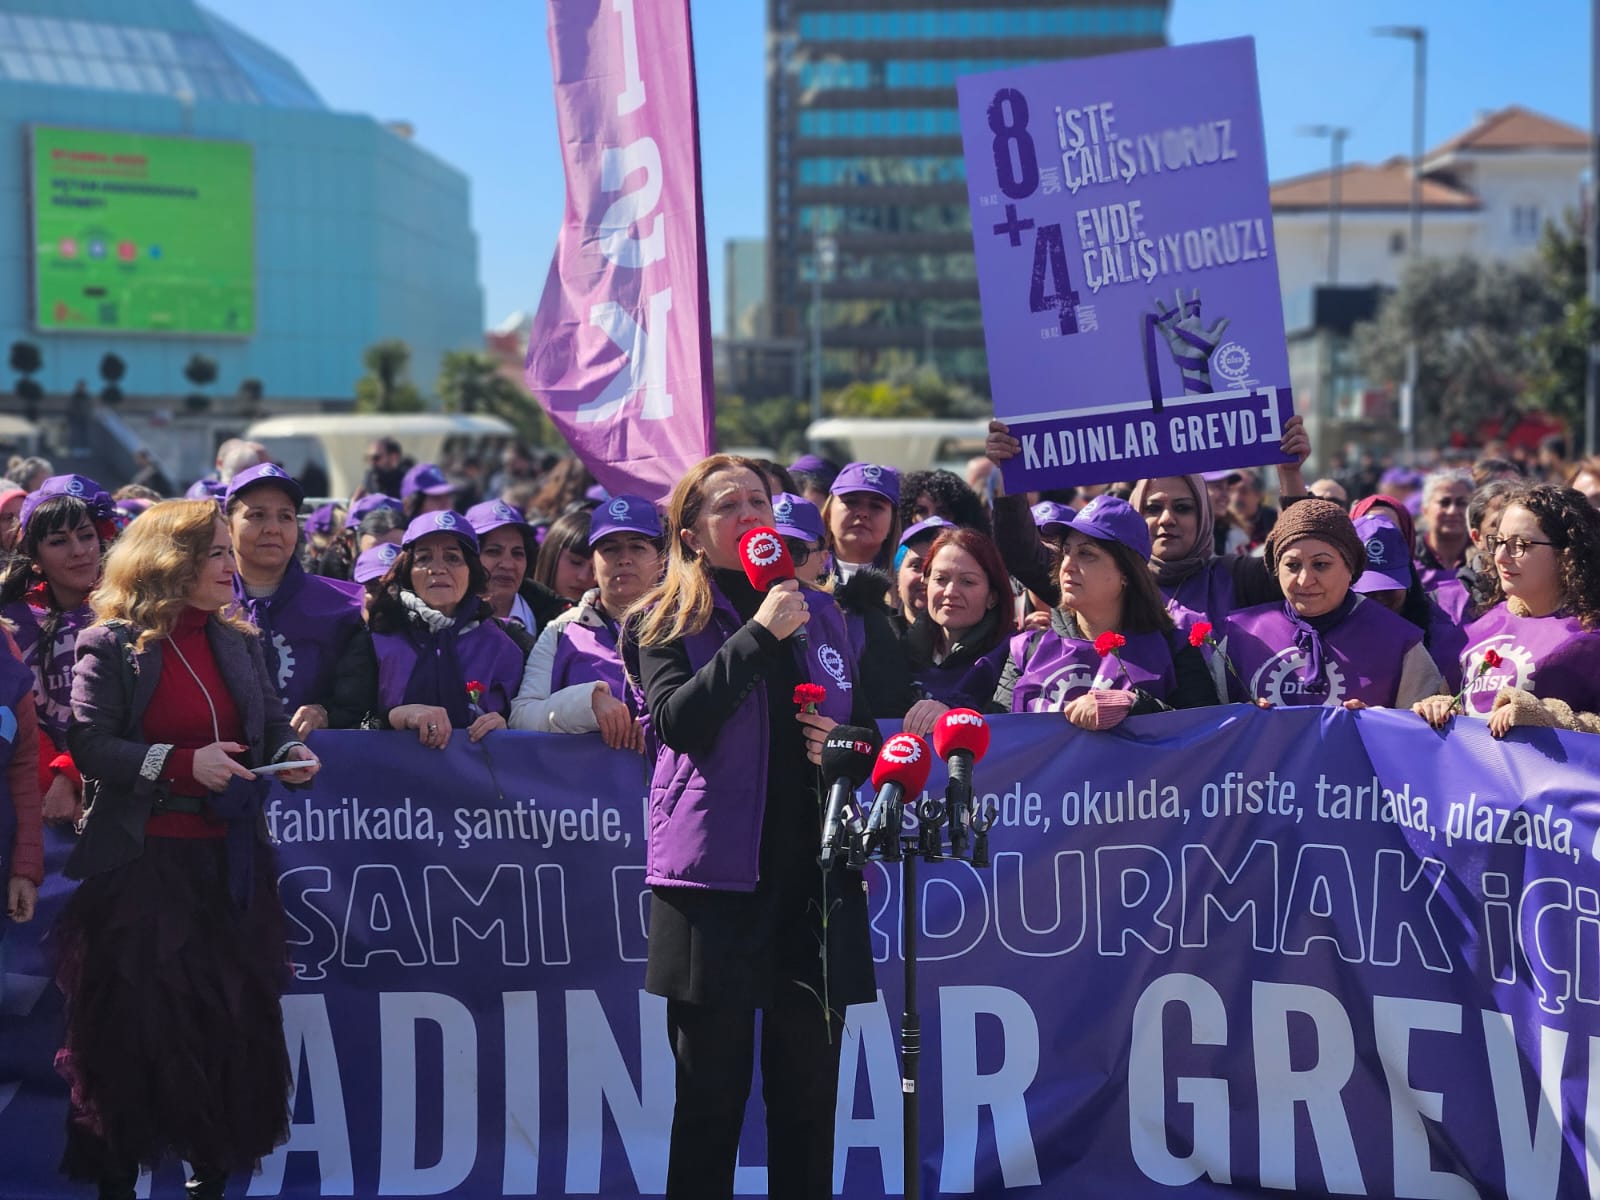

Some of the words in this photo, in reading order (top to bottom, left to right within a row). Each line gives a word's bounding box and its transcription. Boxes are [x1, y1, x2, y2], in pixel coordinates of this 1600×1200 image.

[986, 88, 1039, 200] 8
[1076, 200, 1146, 250] EVDE
[1083, 218, 1268, 294] ÇALIŞIYORUZ!
[1029, 223, 1080, 336] 4
[1020, 420, 1160, 470] KADINLAR
[946, 713, 983, 728] NOW
[1282, 676, 1328, 695] Dİ
[267, 797, 445, 847] fabrikada,
[454, 798, 632, 848] şantiyede,
[1062, 779, 1191, 825] okulda,
[1201, 771, 1304, 823] ofiste,
[1315, 774, 1436, 842] tarlada,
[1446, 793, 1581, 865] plazada,
[136, 985, 1042, 1198] ADINAR
[1128, 973, 1600, 1200] GREV
